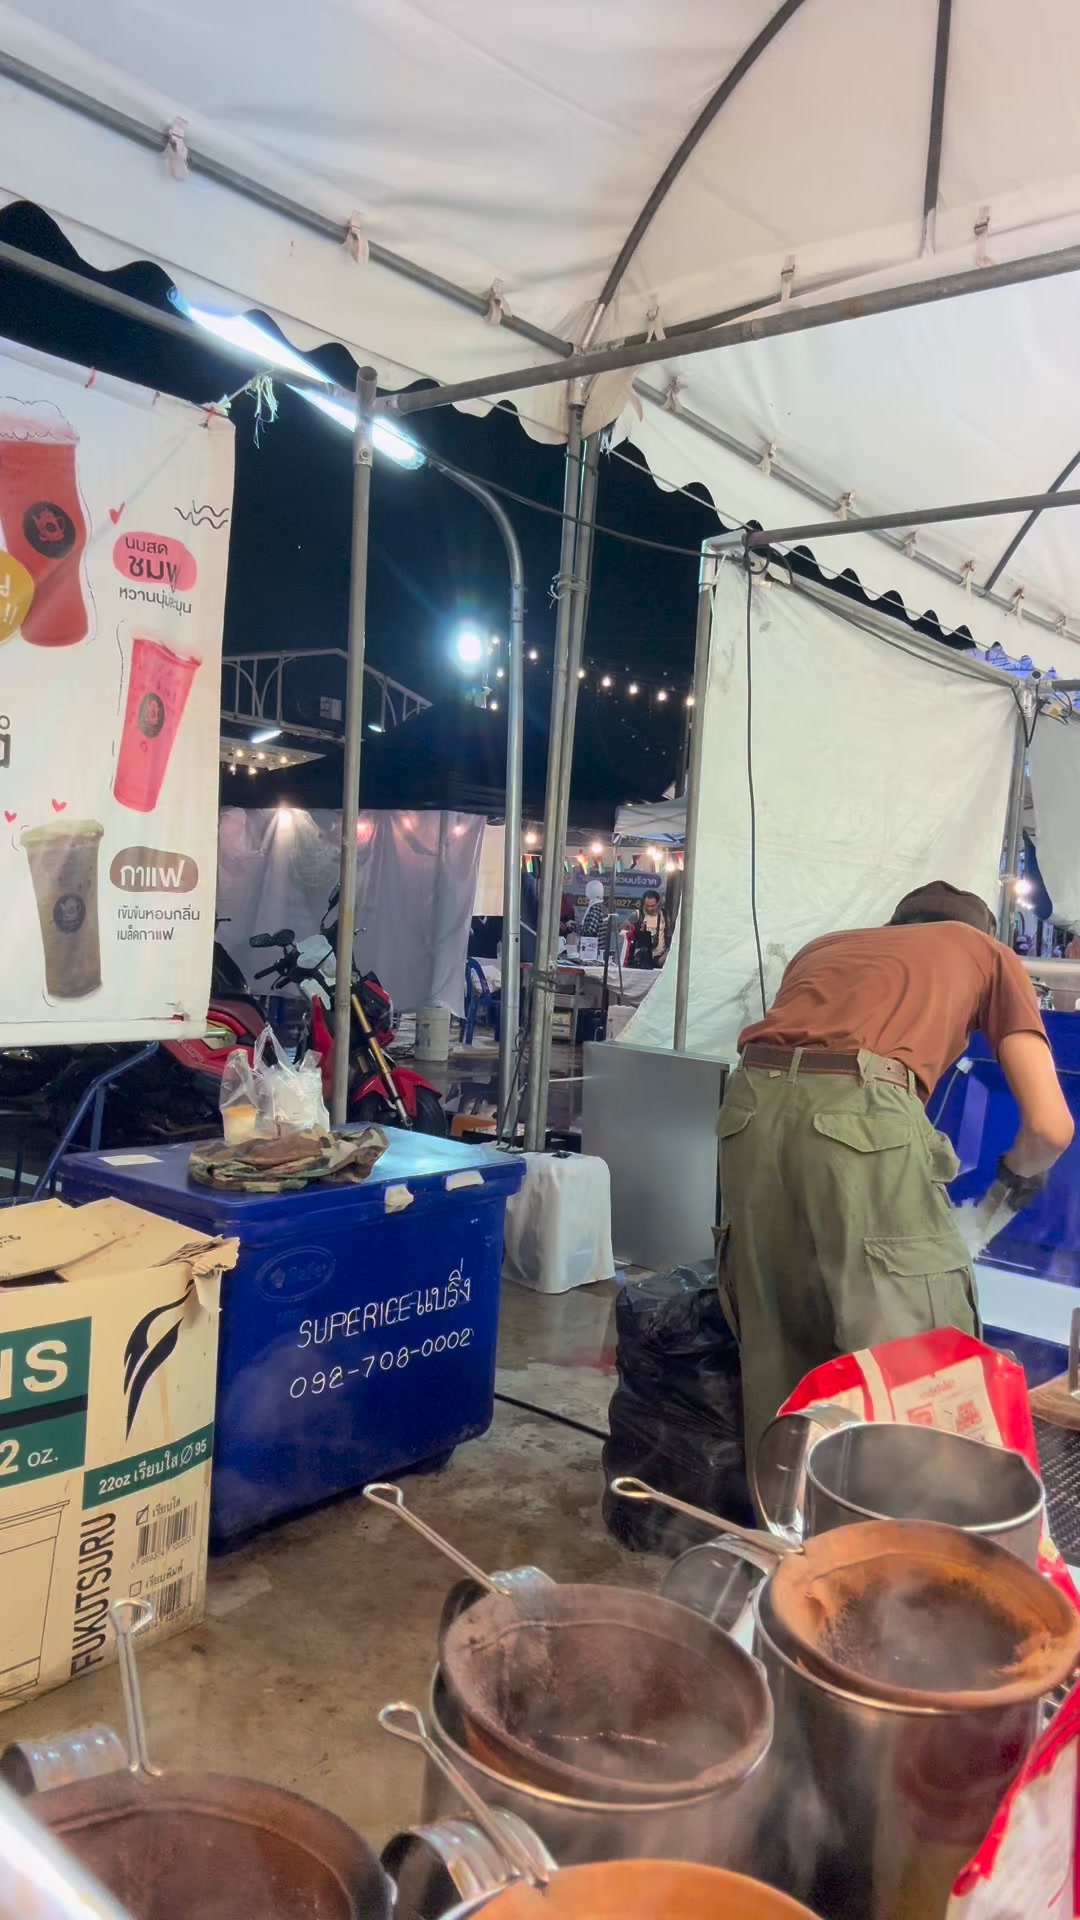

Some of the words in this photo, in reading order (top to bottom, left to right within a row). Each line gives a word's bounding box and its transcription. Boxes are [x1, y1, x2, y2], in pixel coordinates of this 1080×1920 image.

[125, 536, 168, 555] นมสด
[119, 586, 192, 616] หวานนุ่มละมุน
[119, 859, 186, 888] กาแฟ
[117, 904, 201, 921] เข้มข้นหอมกลิ่น
[116, 924, 175, 941] เมล็ดกาแฟ
[290, 1328, 474, 1399] 092-708-0002
[98, 1474, 131, 1495] 22oz
[133, 1450, 179, 1482] เรียบใส
[194, 1438, 207, 1456] 95
[70, 1512, 117, 1676] FUKUTSURU
